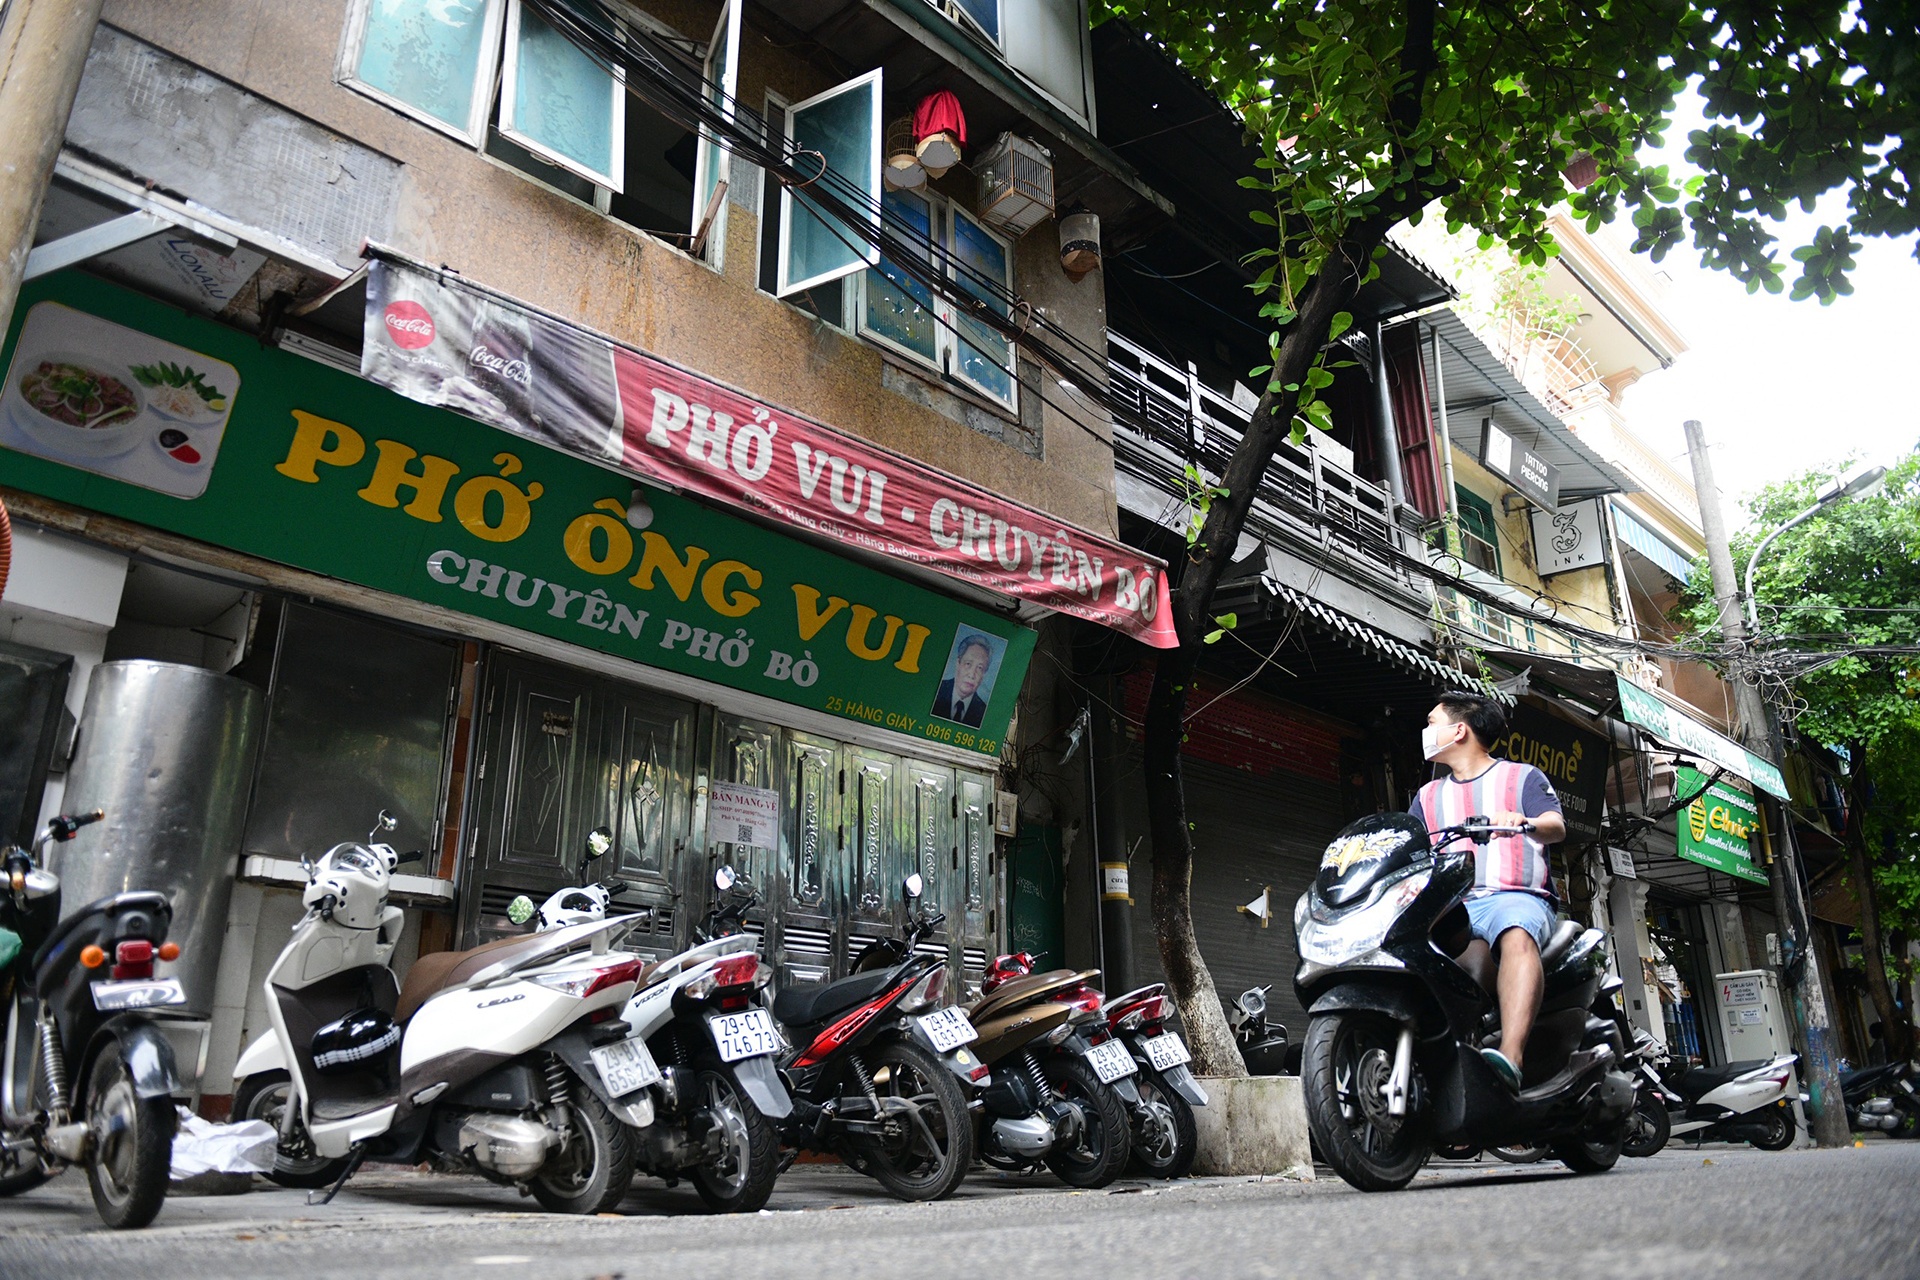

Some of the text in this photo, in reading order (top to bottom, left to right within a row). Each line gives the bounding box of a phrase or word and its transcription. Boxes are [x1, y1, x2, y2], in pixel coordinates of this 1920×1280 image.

[385, 314, 433, 336] Coca-Cola
[1524, 452, 1548, 477] TATTOO
[1521, 465, 1549, 492] PIERCING
[646, 388, 778, 482] PHỞ
[792, 441, 888, 524] VUI
[930, 499, 1103, 601] CHUYÊN
[1114, 564, 1158, 622] BÒ
[275, 409, 931, 674] PHỞ ÔNG VUI
[856, 532, 885, 551] Hàng
[1554, 554, 1584, 566] INK
[427, 550, 820, 687] CHUYÊN PHỞ BÒ
[826, 696, 843, 711] 25
[846, 697, 883, 727] HÀNG
[926, 723, 951, 742] 0916
[954, 731, 976, 746] 596
[978, 737, 996, 752] 126
[735, 794, 763, 808] MANG
[1571, 796, 1587, 813] FOOD
[477, 994, 526, 1008] LEAD
[634, 984, 671, 1008] VISION
[721, 1013, 763, 1036] 29-C1
[925, 1009, 959, 1032] 29-AA
[600, 1040, 642, 1069] 29-B1
[722, 1031, 775, 1058] 746.73
[1092, 1043, 1122, 1064] 29-D1
[1149, 1036, 1177, 1054] 29-C1
[1098, 1056, 1134, 1080] 059.32
[1153, 1048, 1188, 1069] 668.51
